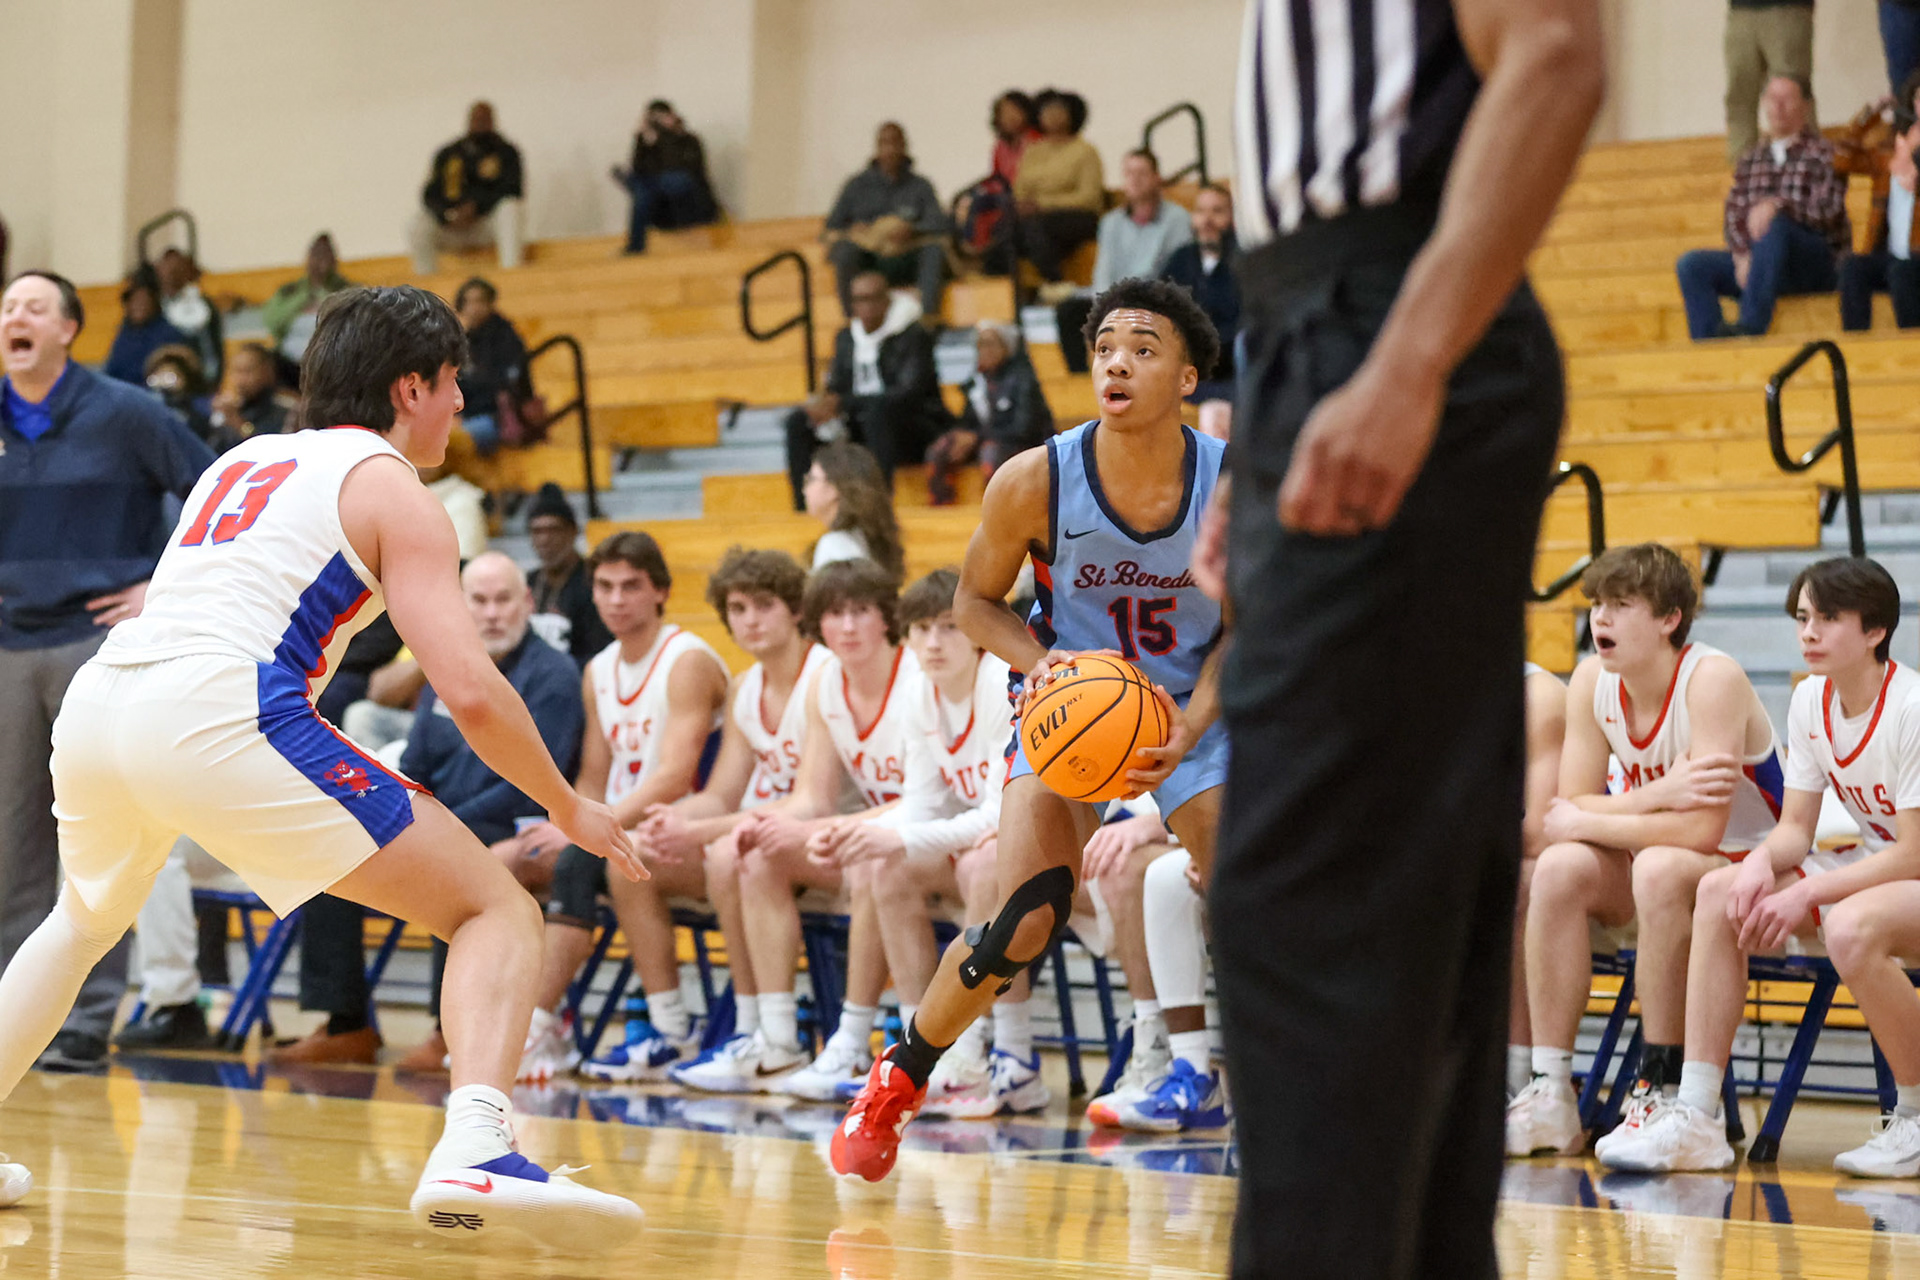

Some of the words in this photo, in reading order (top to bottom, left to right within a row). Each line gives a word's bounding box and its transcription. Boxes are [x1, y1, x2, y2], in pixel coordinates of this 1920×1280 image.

[179, 458, 298, 546] 13
[1073, 563, 1107, 589] St
[1107, 595, 1178, 661] 15
